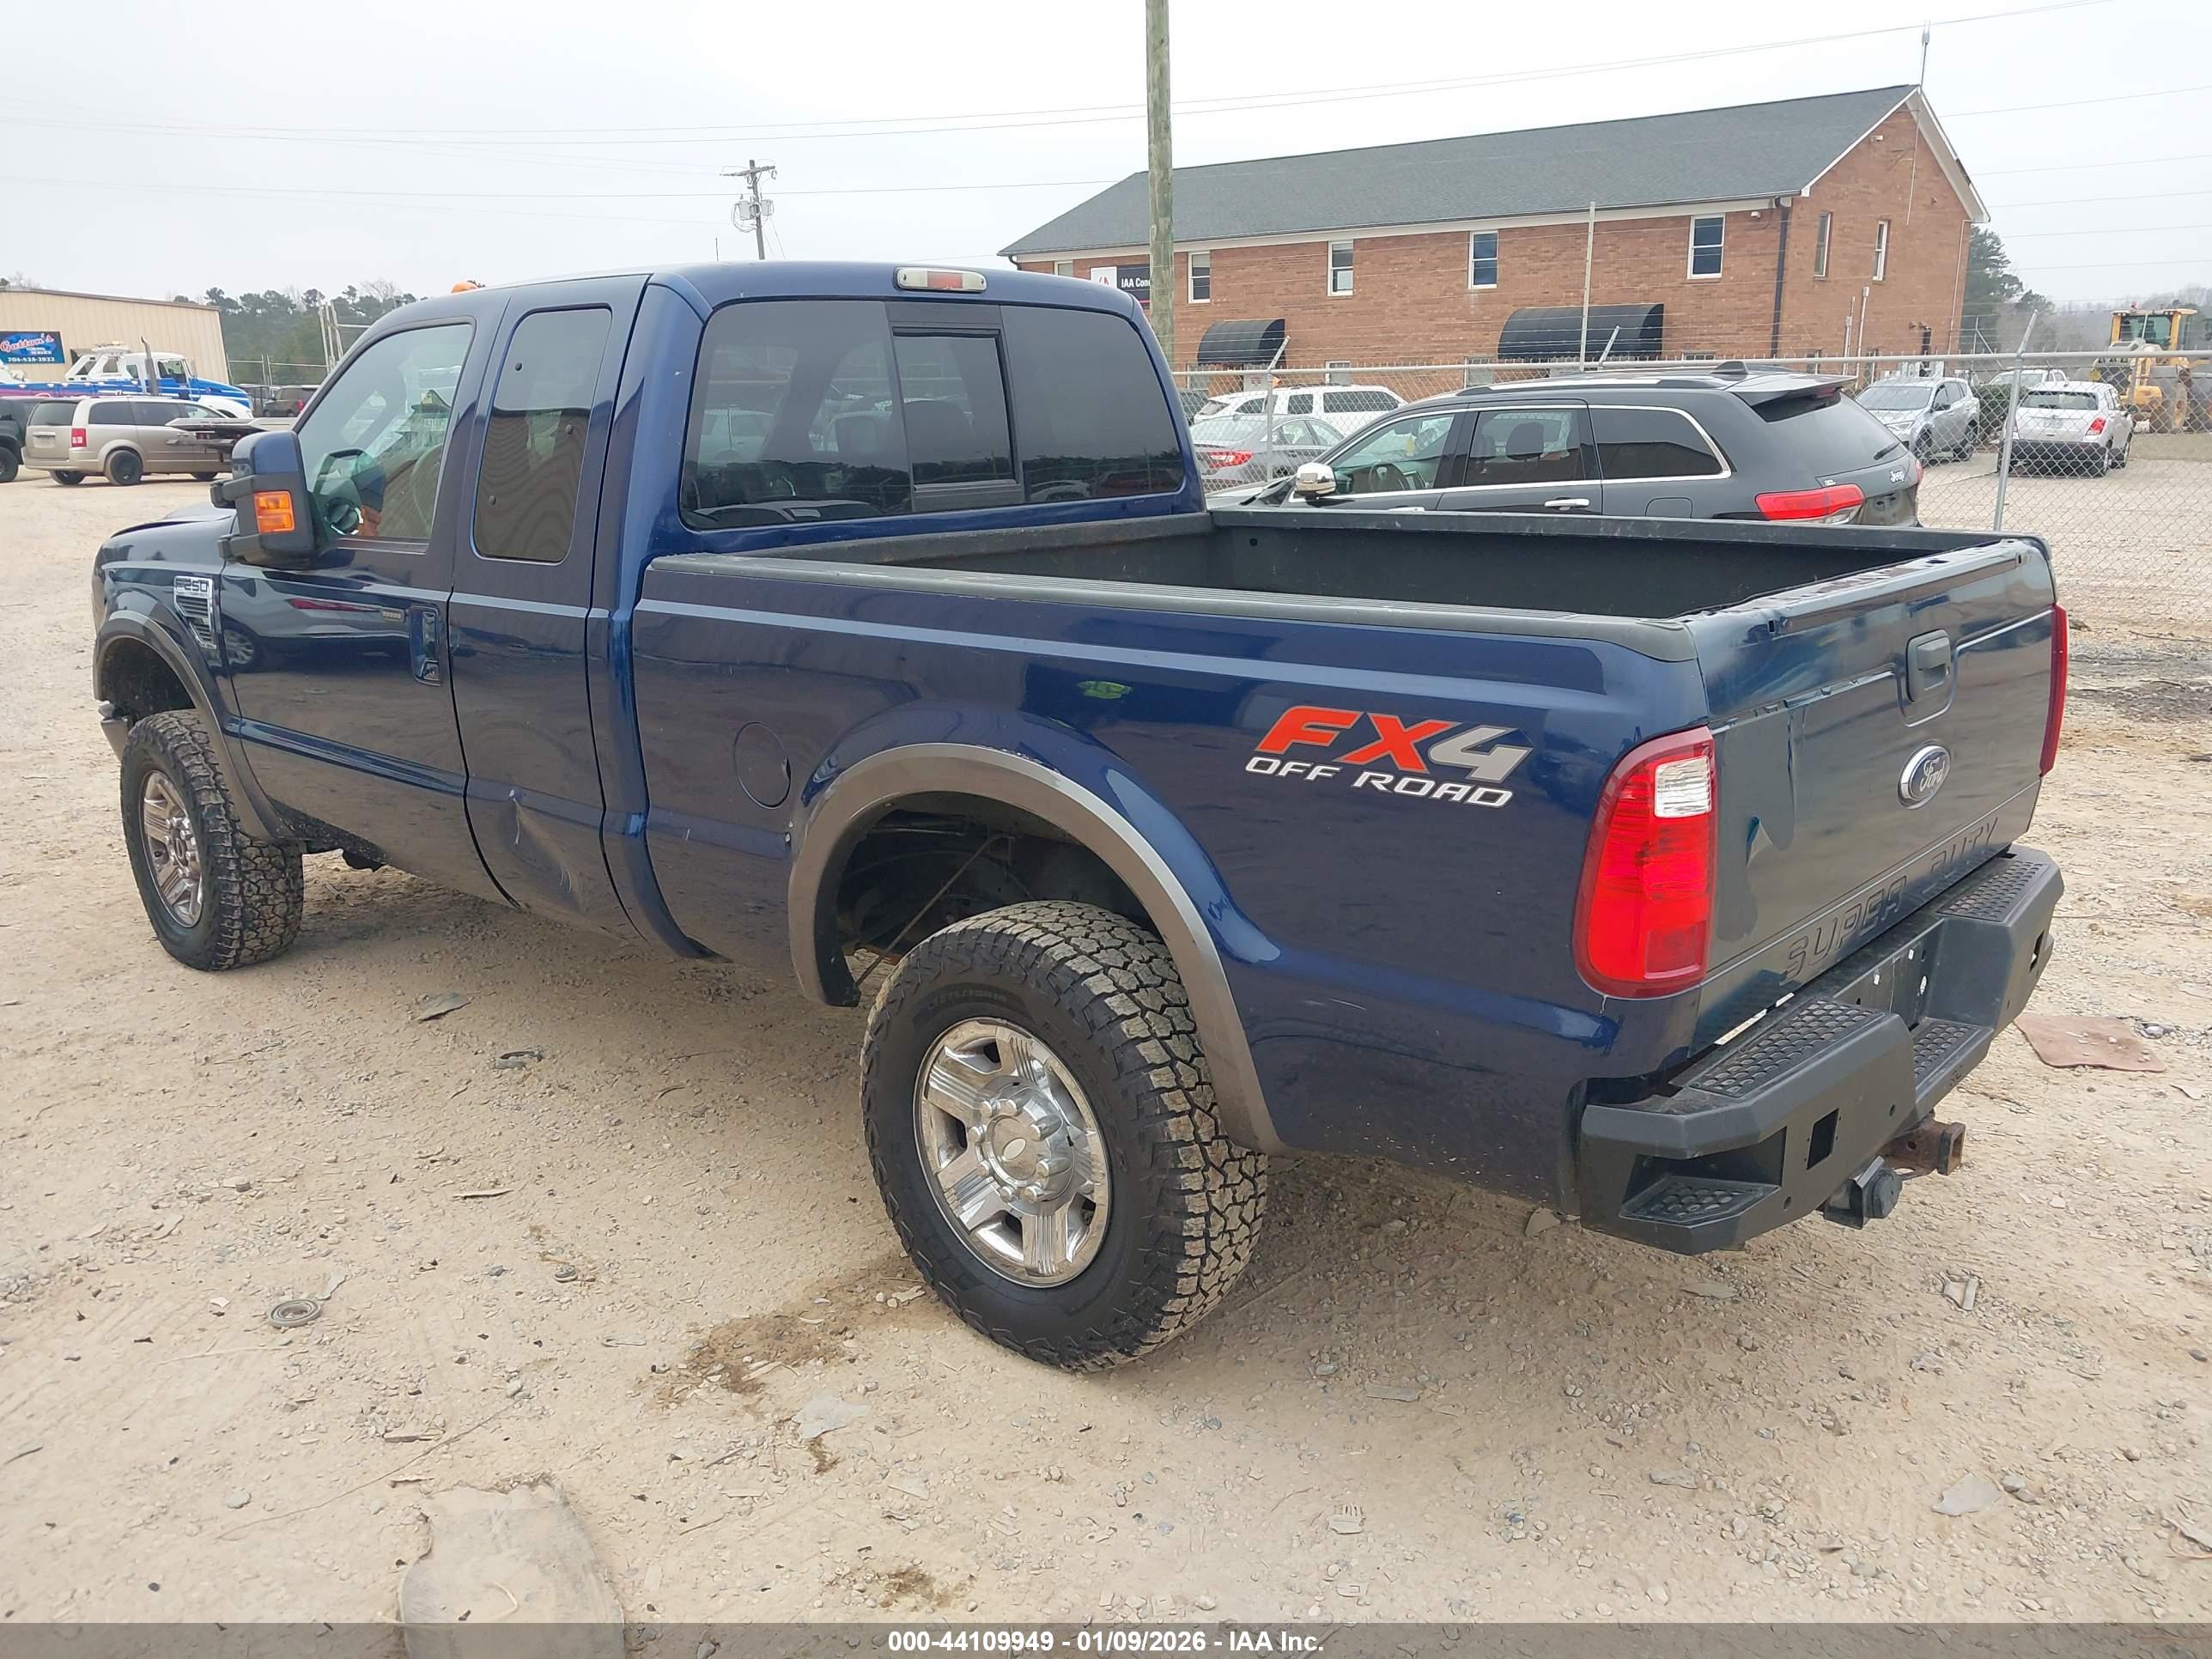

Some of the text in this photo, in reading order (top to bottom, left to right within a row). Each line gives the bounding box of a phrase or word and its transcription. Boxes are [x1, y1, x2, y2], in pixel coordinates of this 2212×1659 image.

[1121, 277, 1134, 289] IAA
[1889, 469, 1905, 483] Jeep
[1254, 705, 1534, 784] FX4
[1244, 755, 1516, 809] OFF ROAD
[1918, 756, 1947, 793] Ford
[1779, 816, 1999, 987] SUPER DUTY
